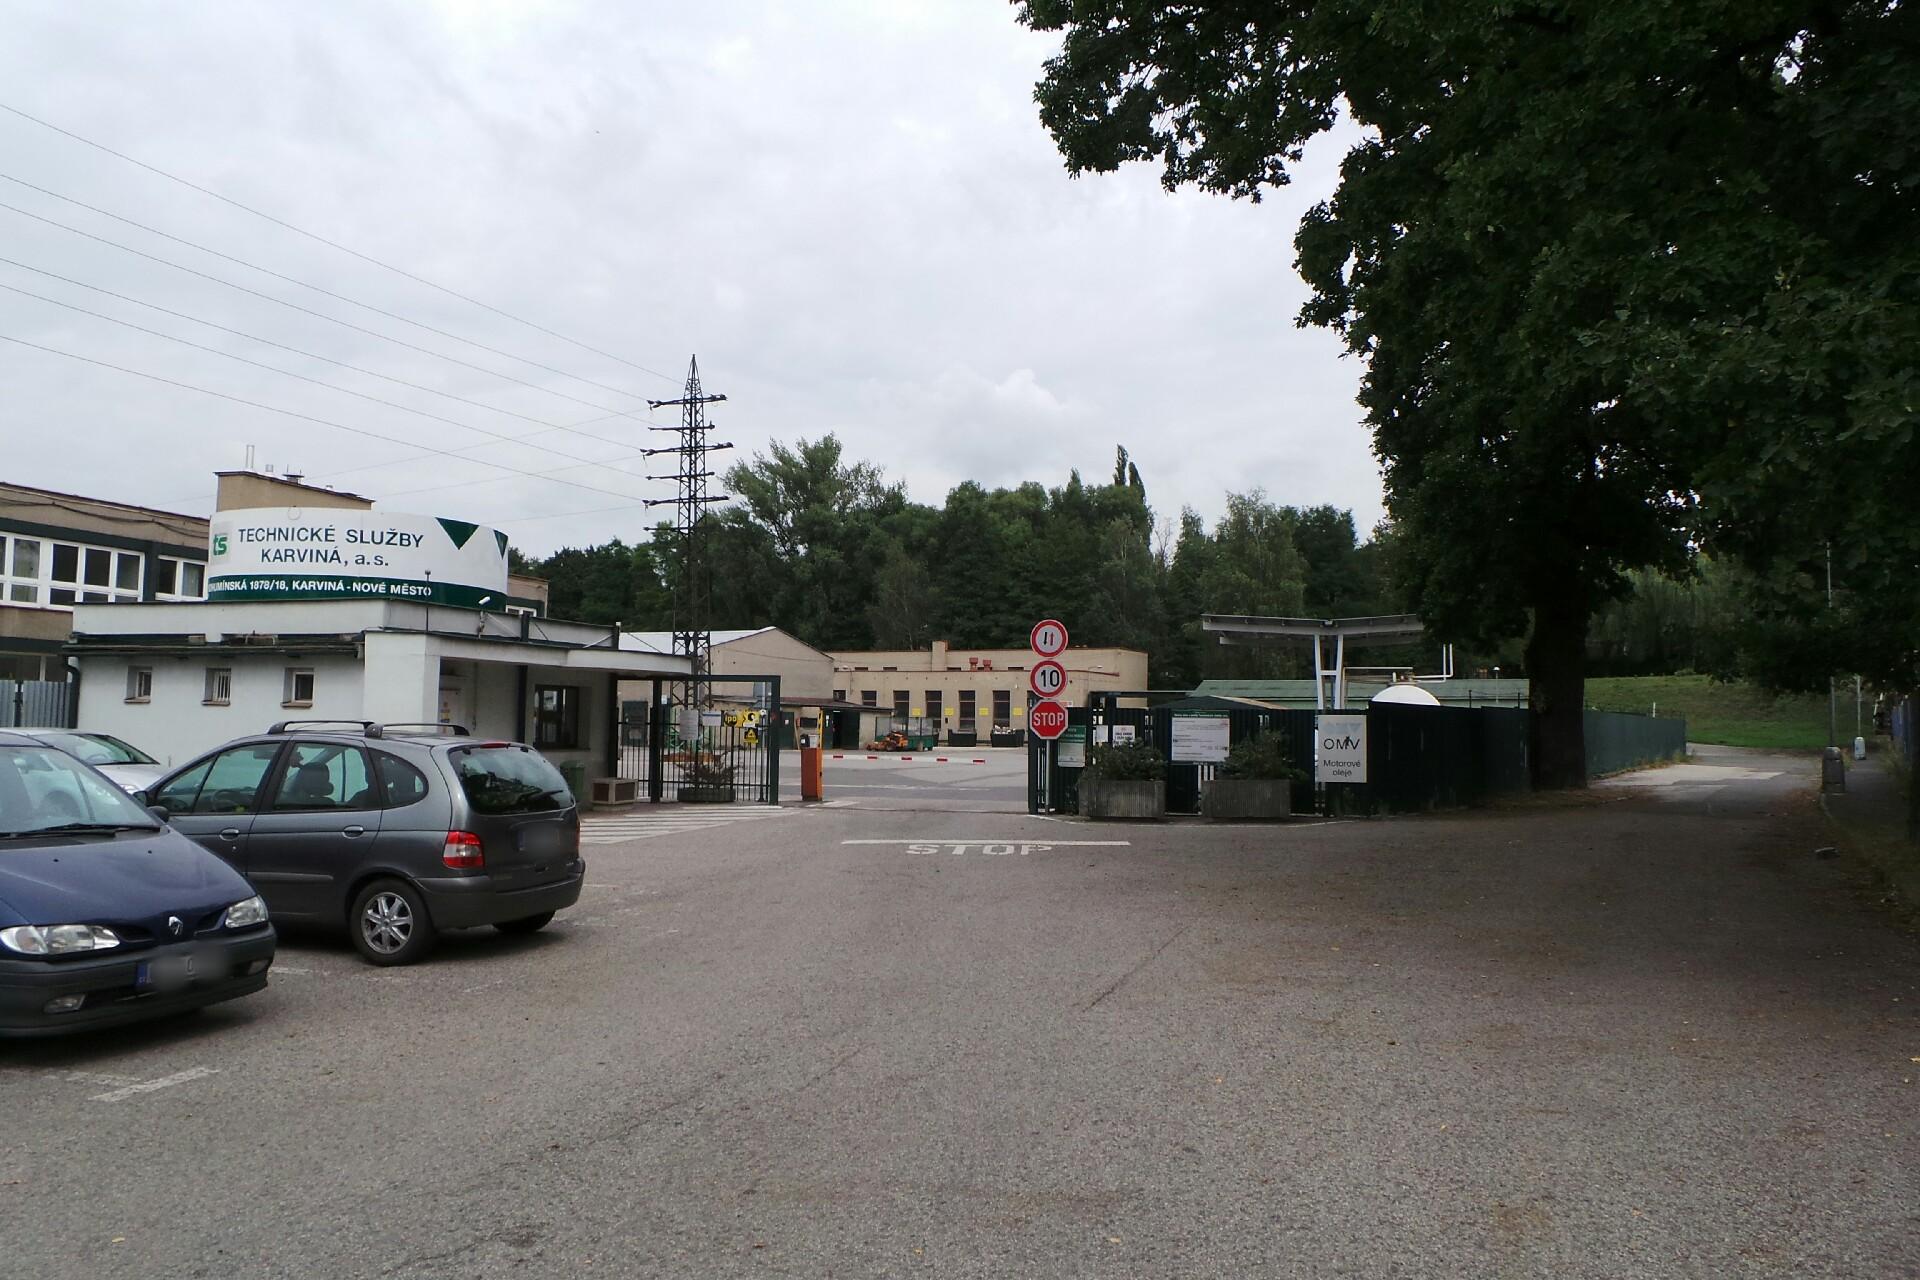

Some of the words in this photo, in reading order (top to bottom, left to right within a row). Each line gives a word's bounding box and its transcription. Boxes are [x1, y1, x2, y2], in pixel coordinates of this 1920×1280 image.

[238, 524, 336, 543] TECHNICKÉ
[345, 527, 424, 548] SLUŽBY
[261, 545, 349, 567] KARVINÁ,
[292, 580, 345, 592] KARVINÁ
[352, 582, 387, 594] NOVÉ
[390, 583, 432, 596] MĚSTO
[1040, 669, 1060, 688] 10
[1033, 712, 1065, 727] STOP
[1323, 738, 1361, 750] OMV
[1323, 759, 1361, 768] Motorové
[906, 844, 1053, 856] STOP
